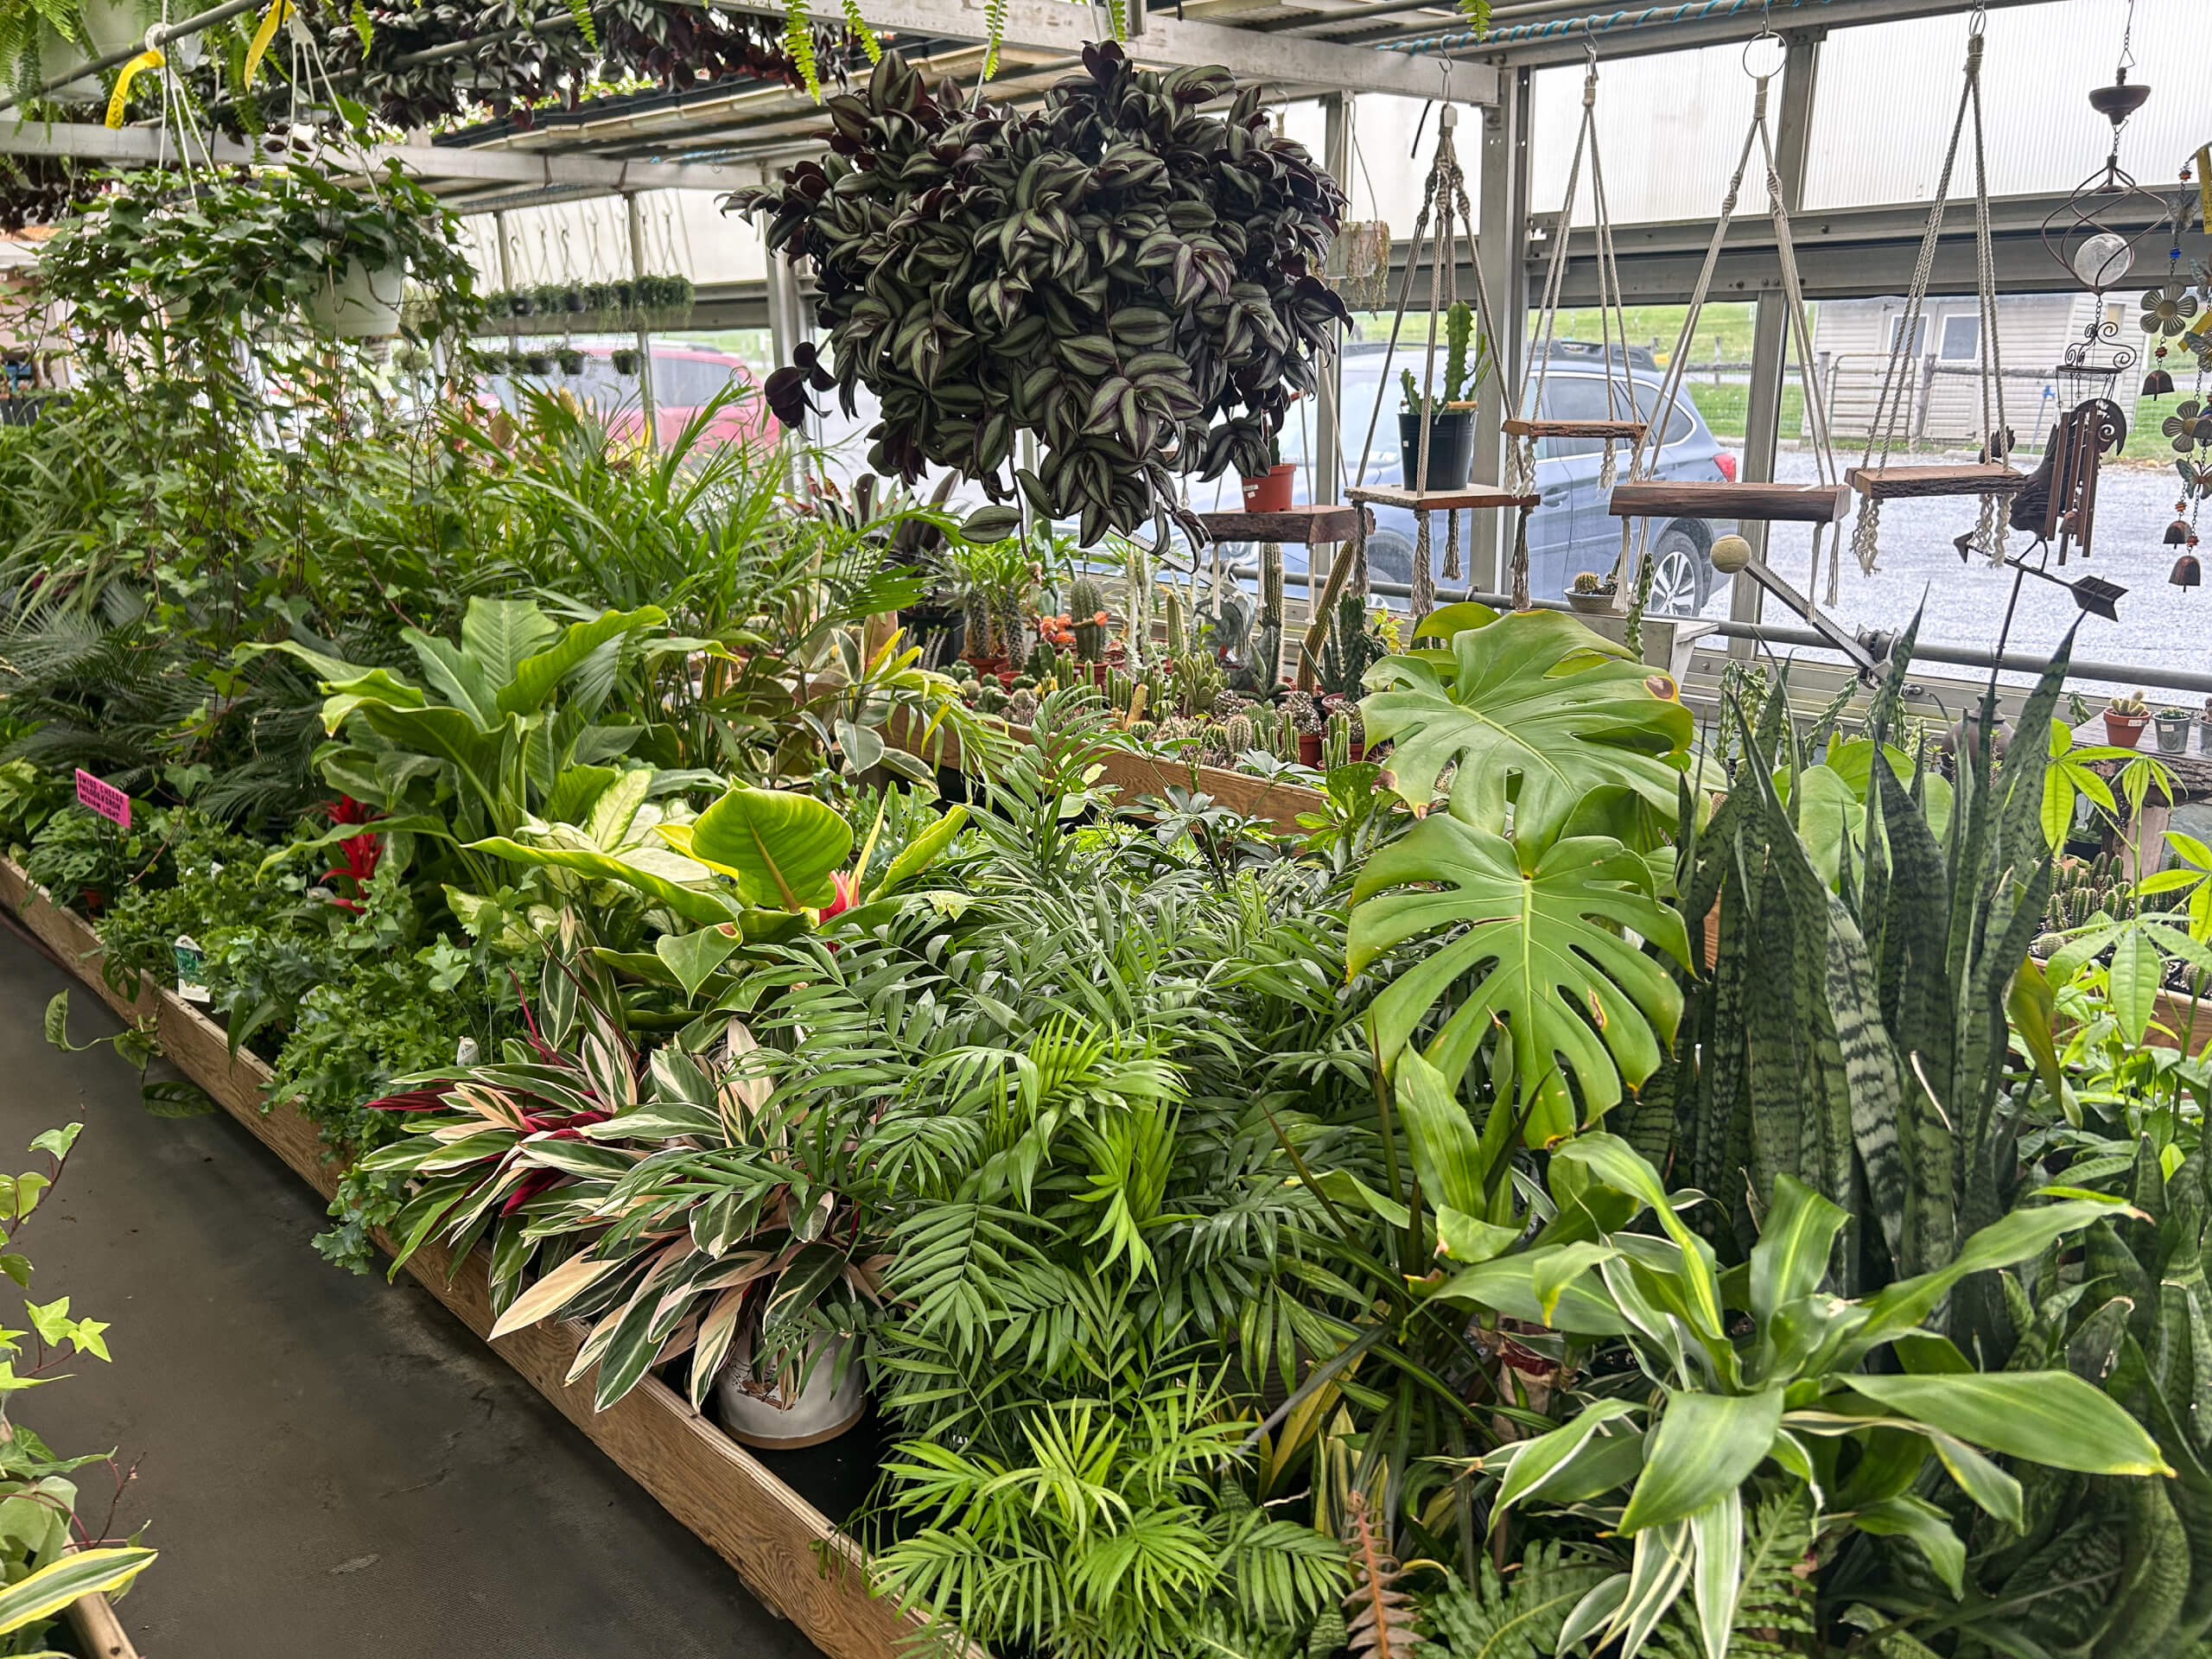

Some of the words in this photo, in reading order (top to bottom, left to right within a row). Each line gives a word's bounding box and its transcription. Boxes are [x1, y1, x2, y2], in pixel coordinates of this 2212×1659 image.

[78, 772, 97, 789] SWISS
[100, 785, 124, 804] CHEESE
[79, 792, 101, 809] MEDIUM
[103, 804, 120, 820] LIGHT
